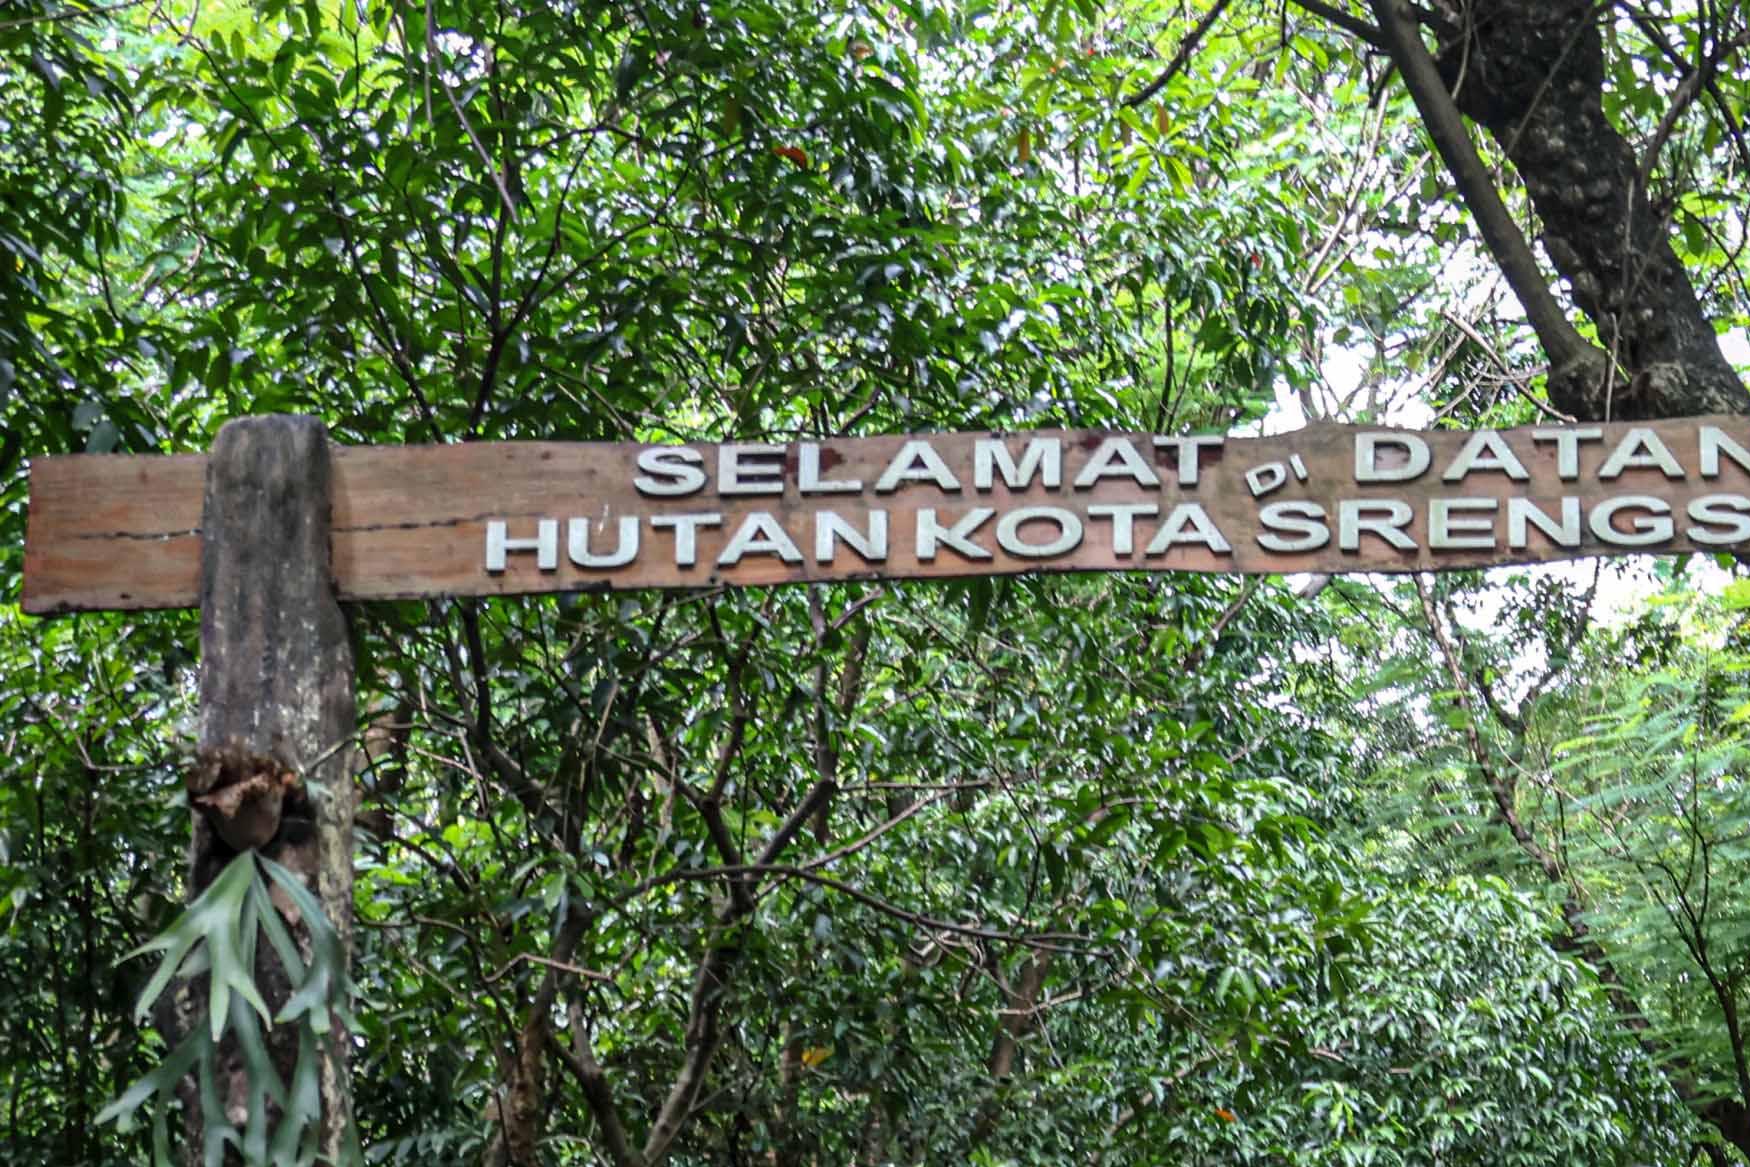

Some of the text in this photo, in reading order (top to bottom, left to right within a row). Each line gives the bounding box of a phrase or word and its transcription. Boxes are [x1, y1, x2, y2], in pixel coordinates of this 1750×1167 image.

[633, 434, 1225, 497] SELAMAT
[1245, 454, 1308, 497] DI
[486, 509, 889, 572] HUTAN
[916, 502, 1233, 560] KOTA
